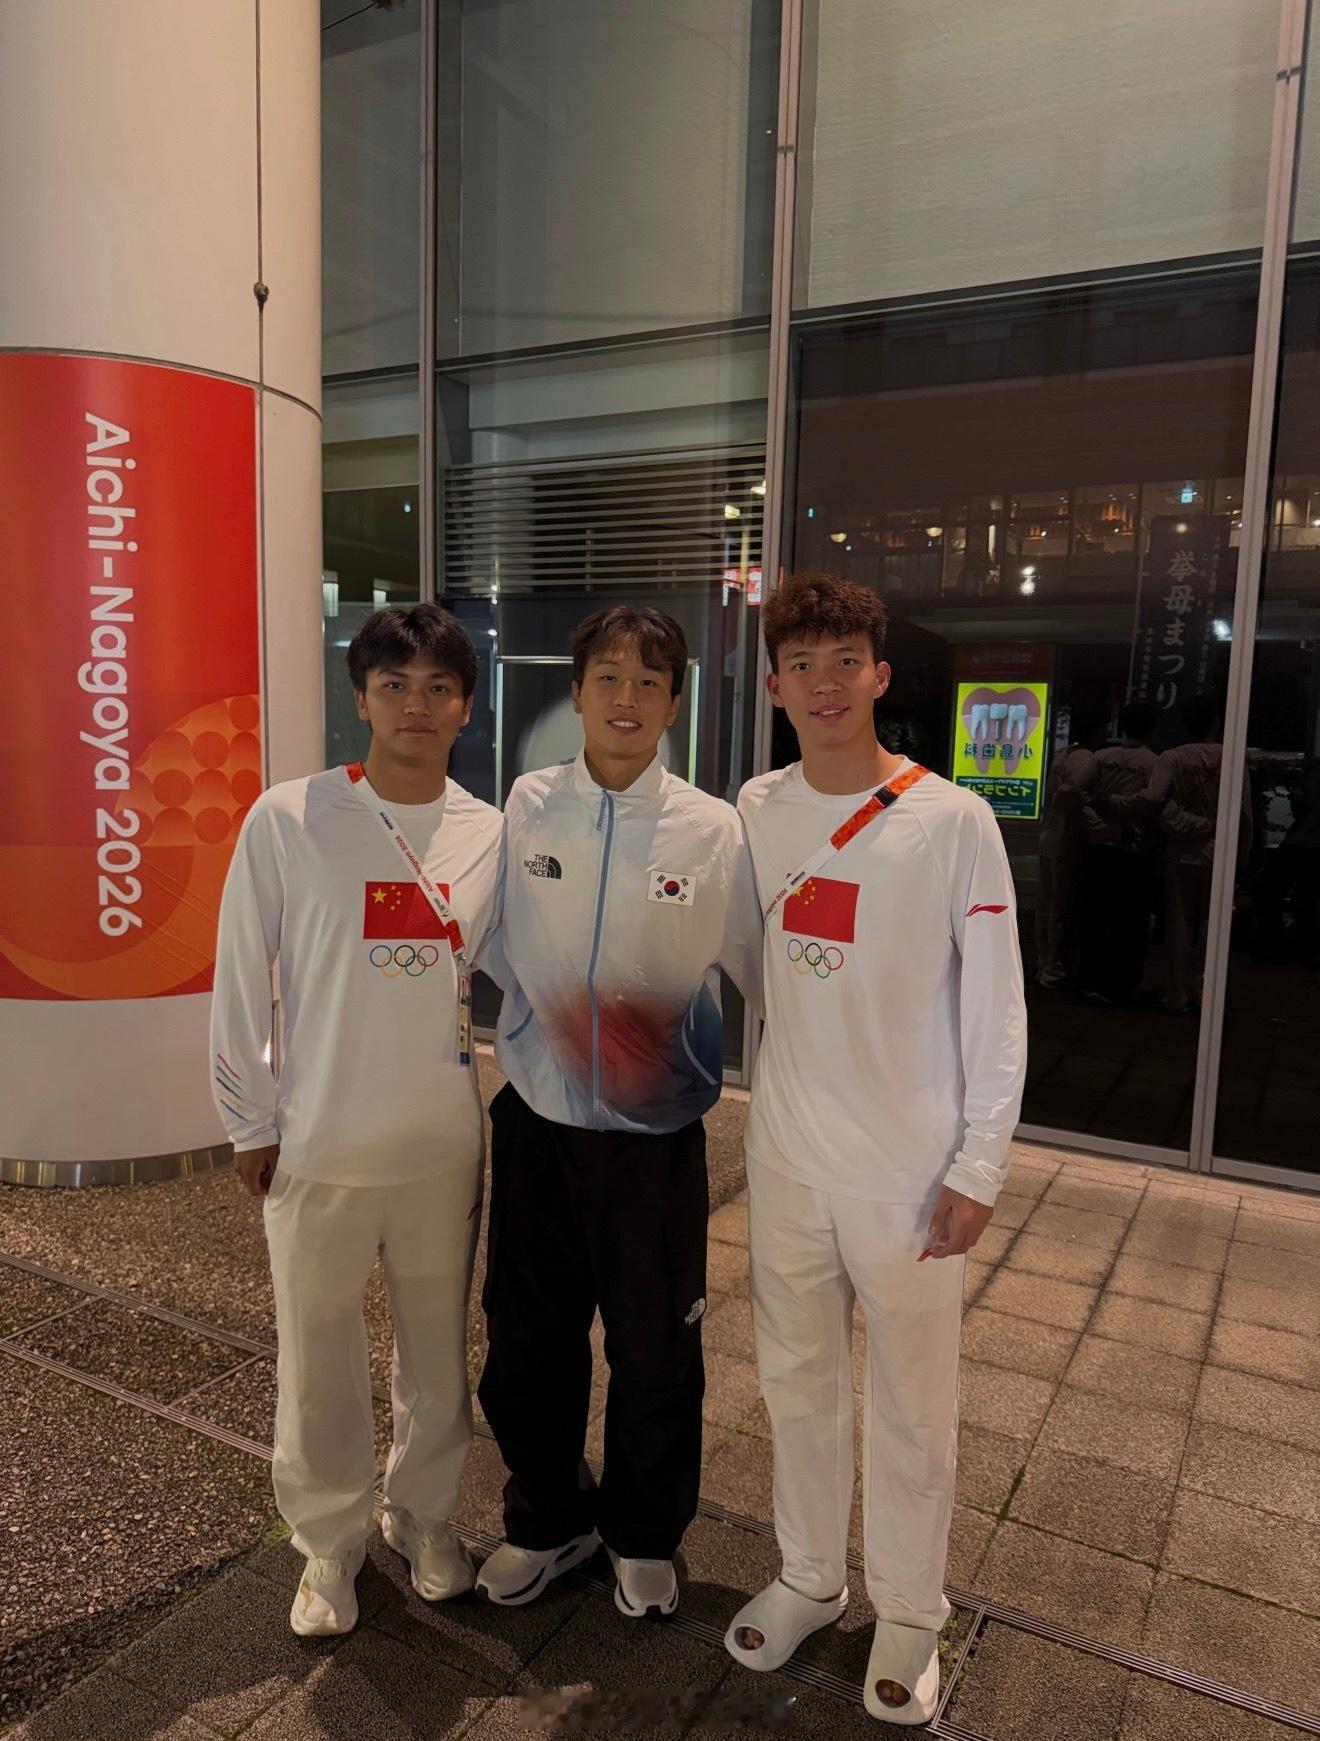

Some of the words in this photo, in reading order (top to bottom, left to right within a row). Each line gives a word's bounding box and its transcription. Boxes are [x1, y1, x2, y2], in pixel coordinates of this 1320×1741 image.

[77, 411, 138, 791] Aichi-Nagoya
[1156, 551, 1198, 710] 挙母まつり
[97, 808, 142, 937] 2026
[523, 860, 548, 870] NORTH
[529, 868, 548, 878] FACE
[534, 854, 549, 863] THE
